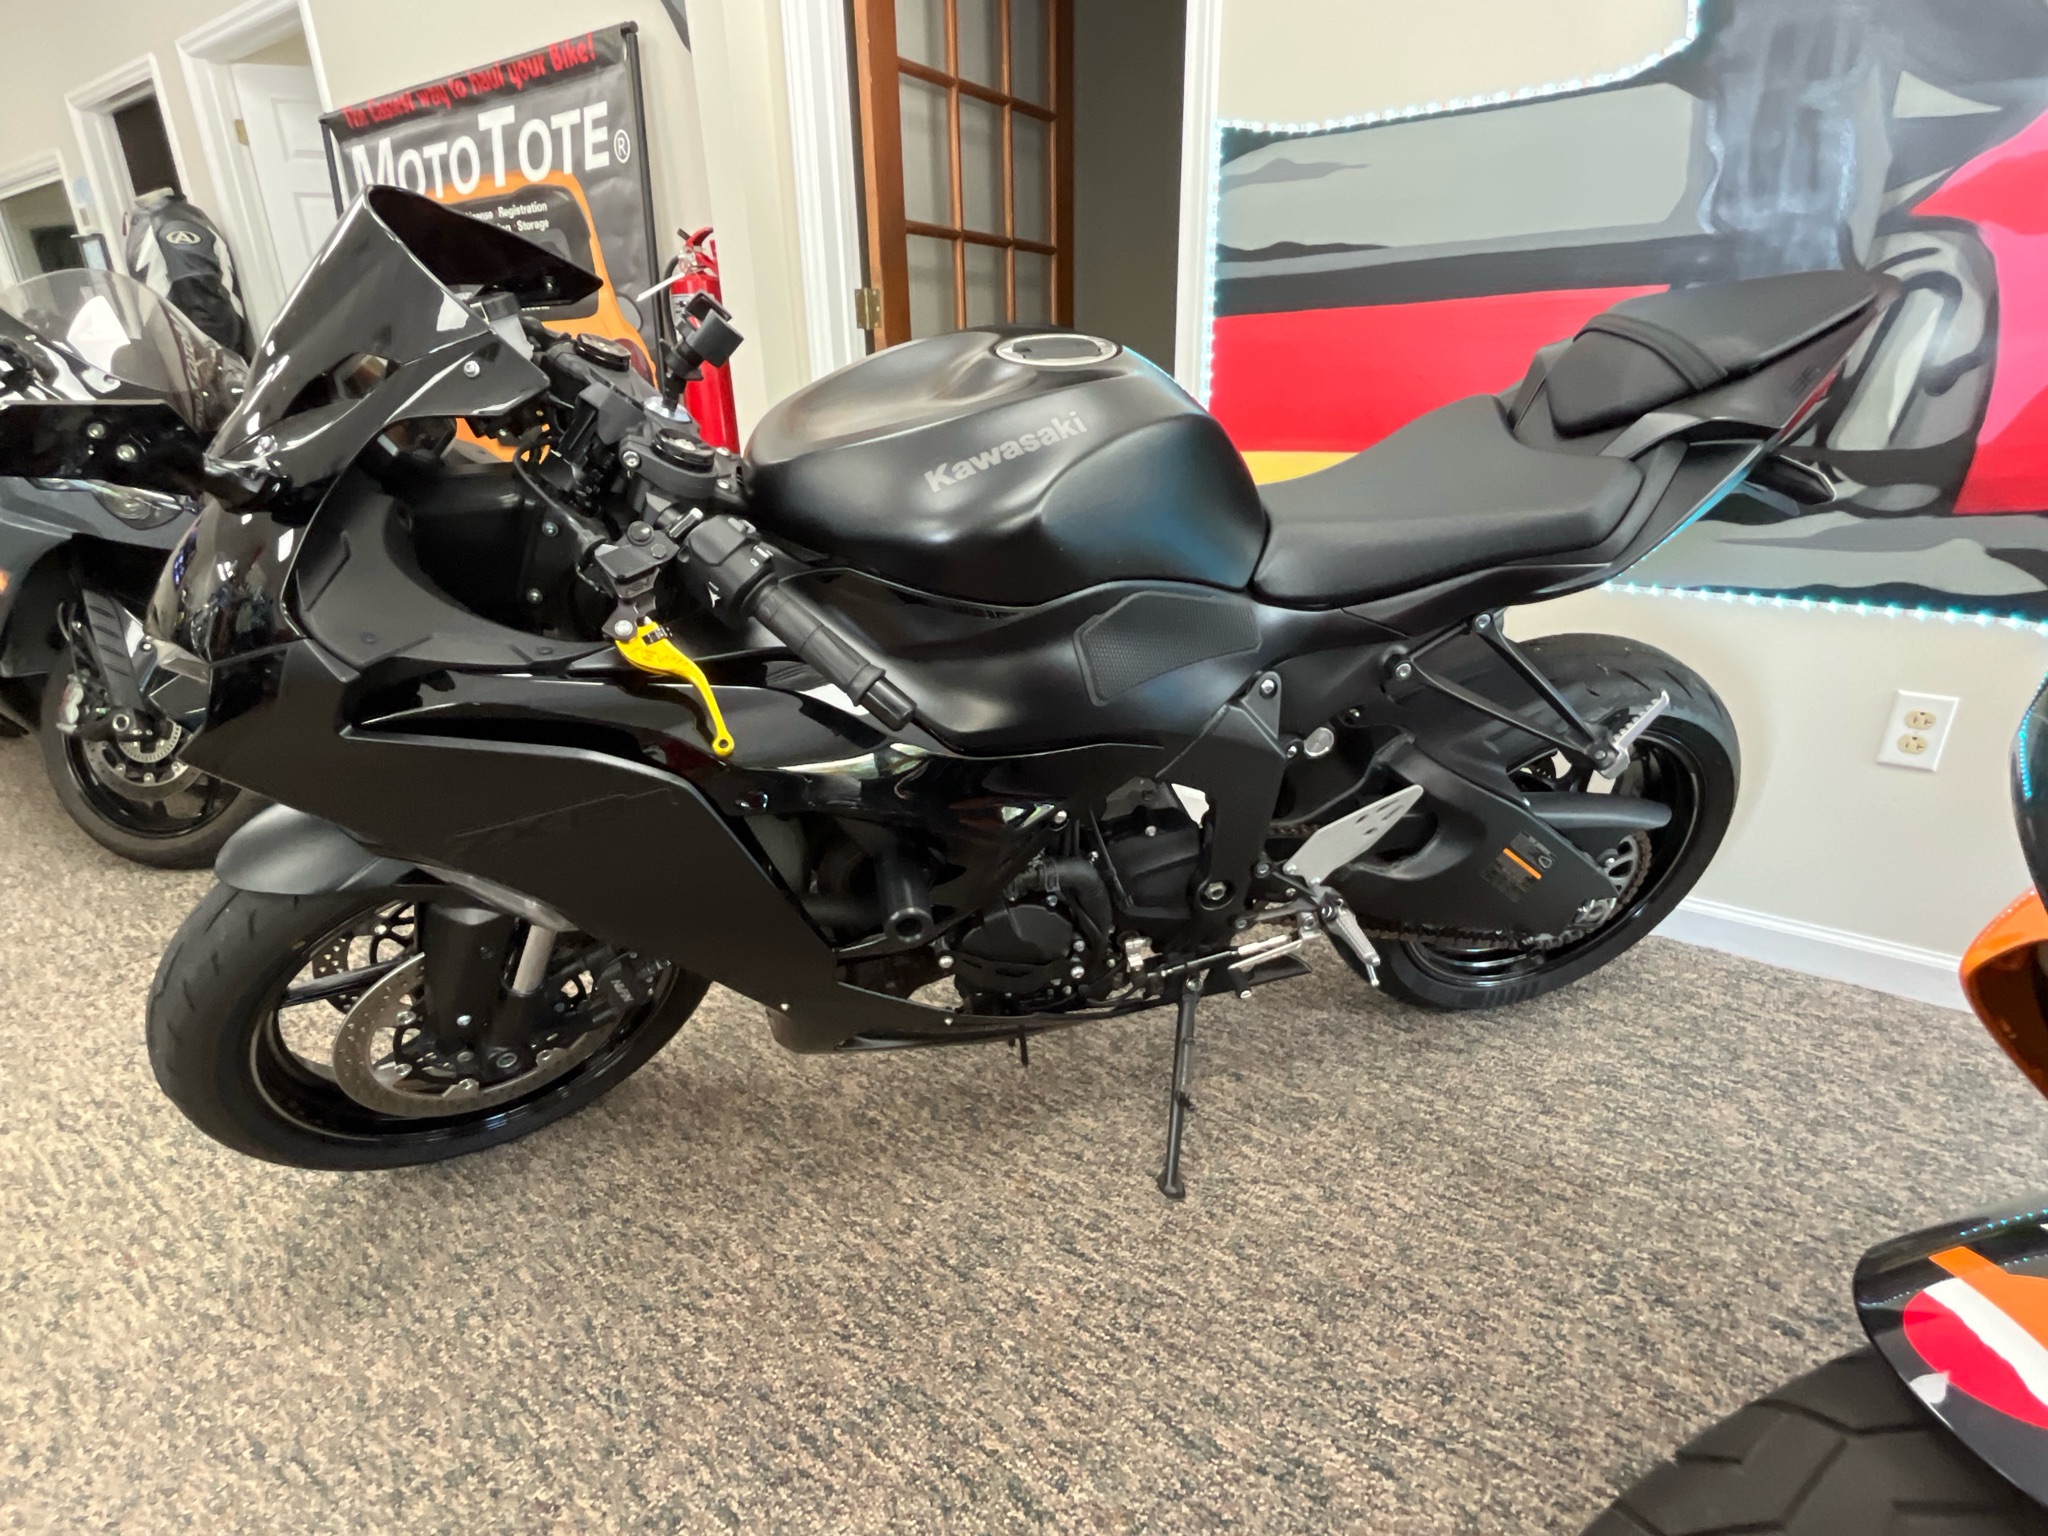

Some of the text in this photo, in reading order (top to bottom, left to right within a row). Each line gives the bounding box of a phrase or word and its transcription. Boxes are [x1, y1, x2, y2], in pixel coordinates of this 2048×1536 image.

[468, 61, 504, 95] haul
[507, 54, 547, 90] your
[549, 32, 597, 72] Bike!
[497, 201, 547, 219] Registration
[516, 219, 550, 232] Storage
[924, 411, 1087, 493] Kawasaki
